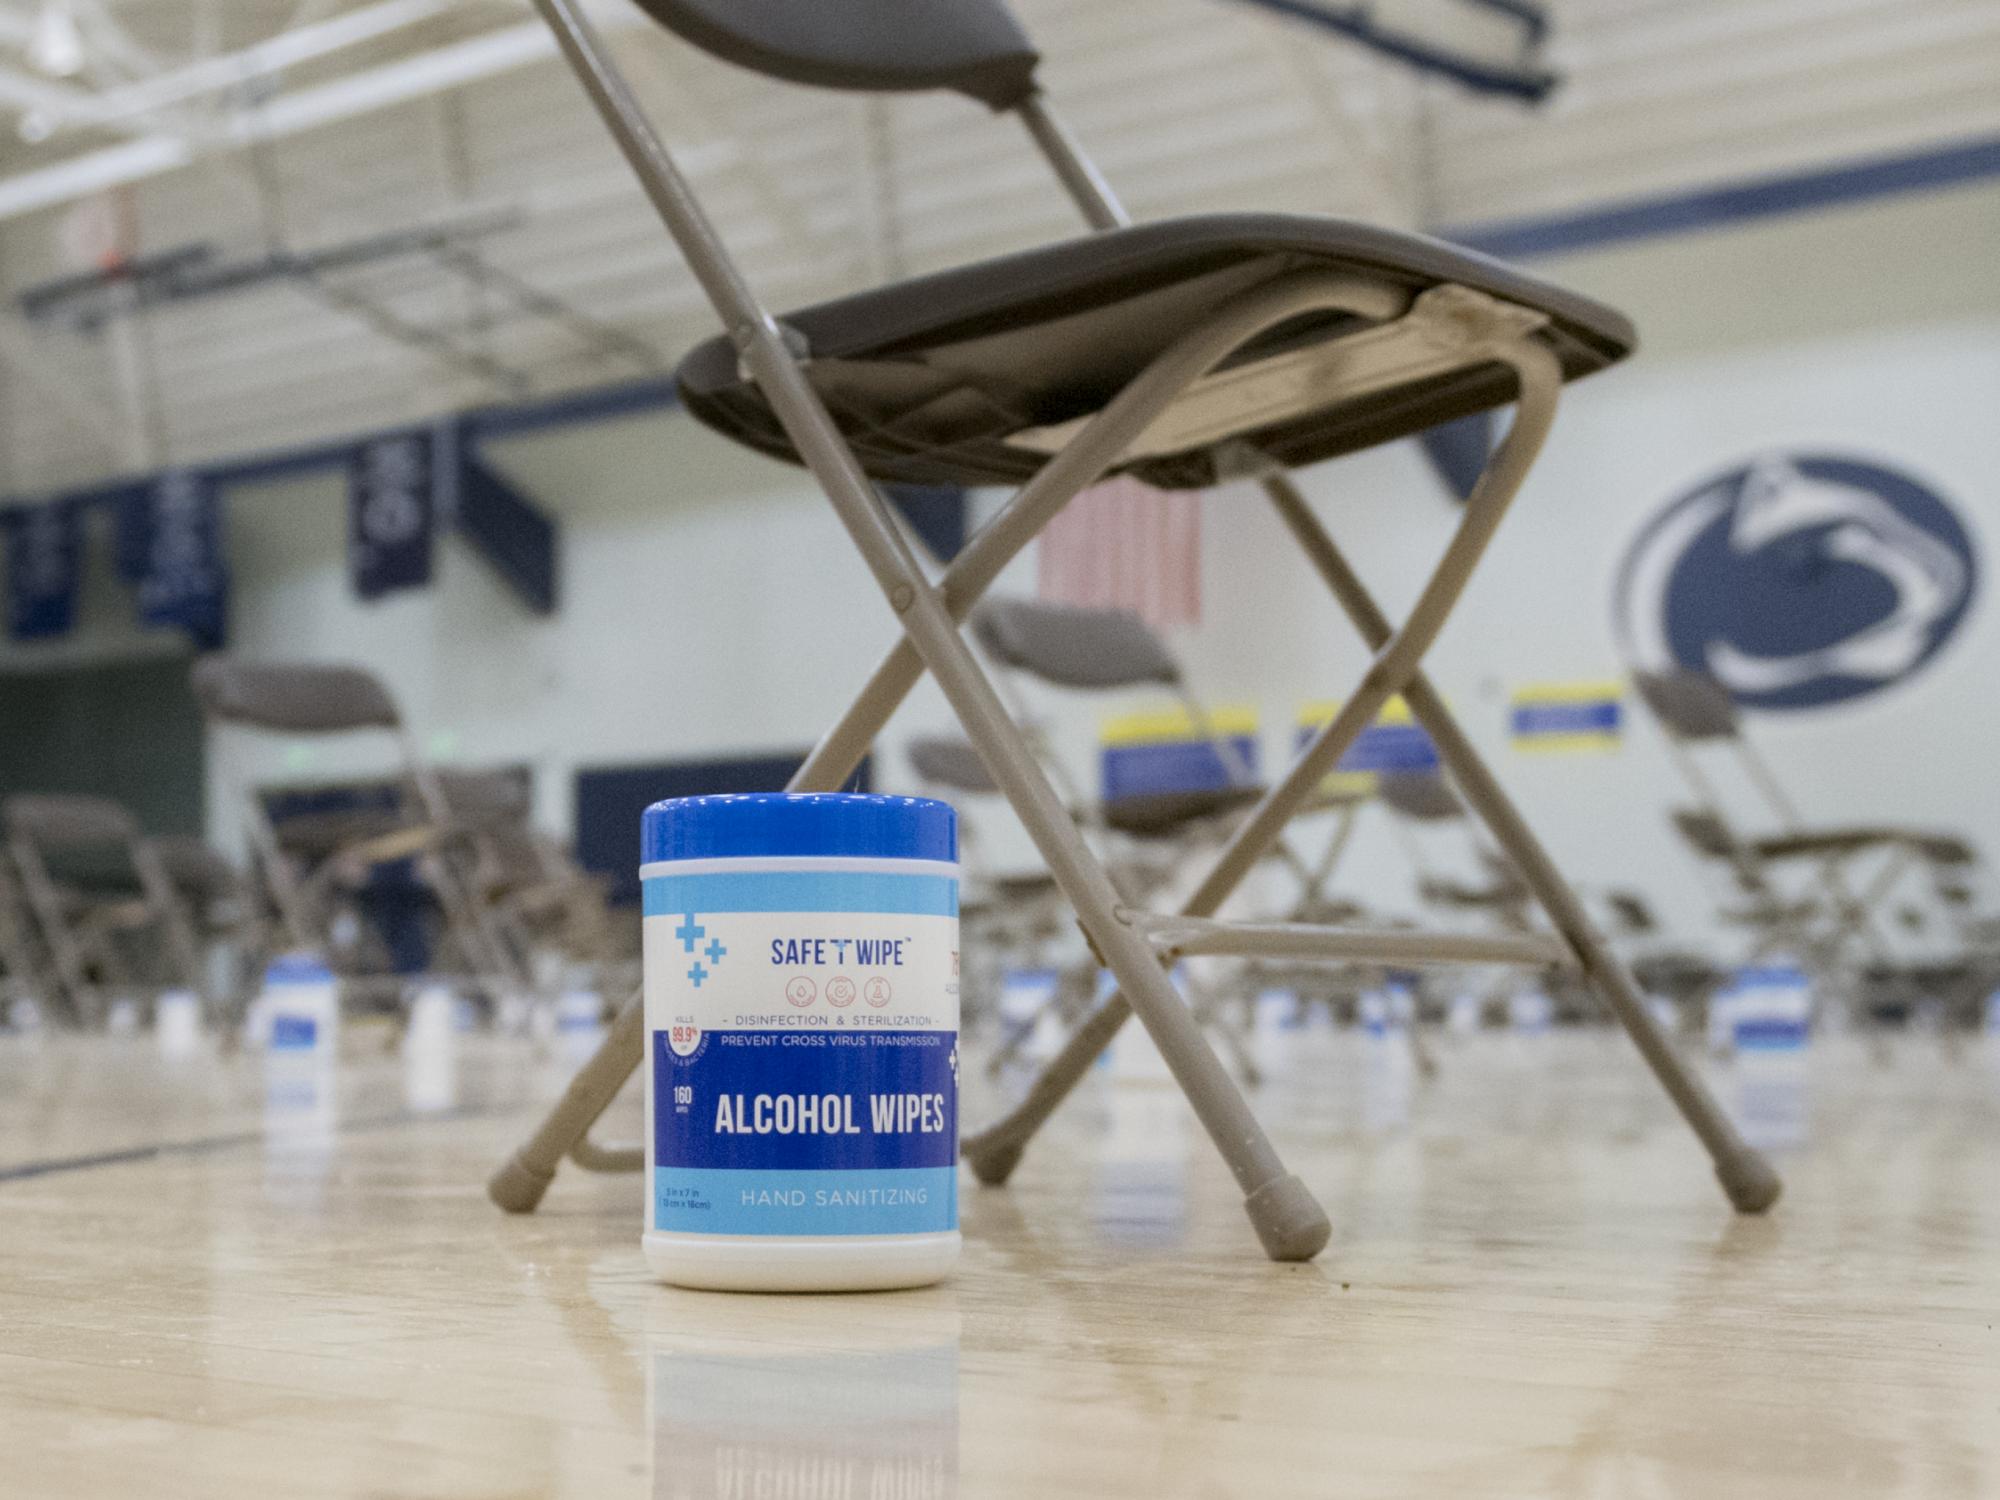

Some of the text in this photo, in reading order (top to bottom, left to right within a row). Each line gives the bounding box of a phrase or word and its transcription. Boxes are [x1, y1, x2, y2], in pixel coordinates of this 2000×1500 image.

[771, 938, 826, 965] SAFE
[735, 1015, 931, 1026] DISINFECTION & STERILIZATION
[721, 1035, 941, 1047] PREVENT CROSS VIRUS TRANSMISSION
[673, 1086, 692, 1104] 160
[715, 1094, 944, 1134] ALCOHOL WIPES
[741, 1188, 927, 1207] HAND SANITIZING
